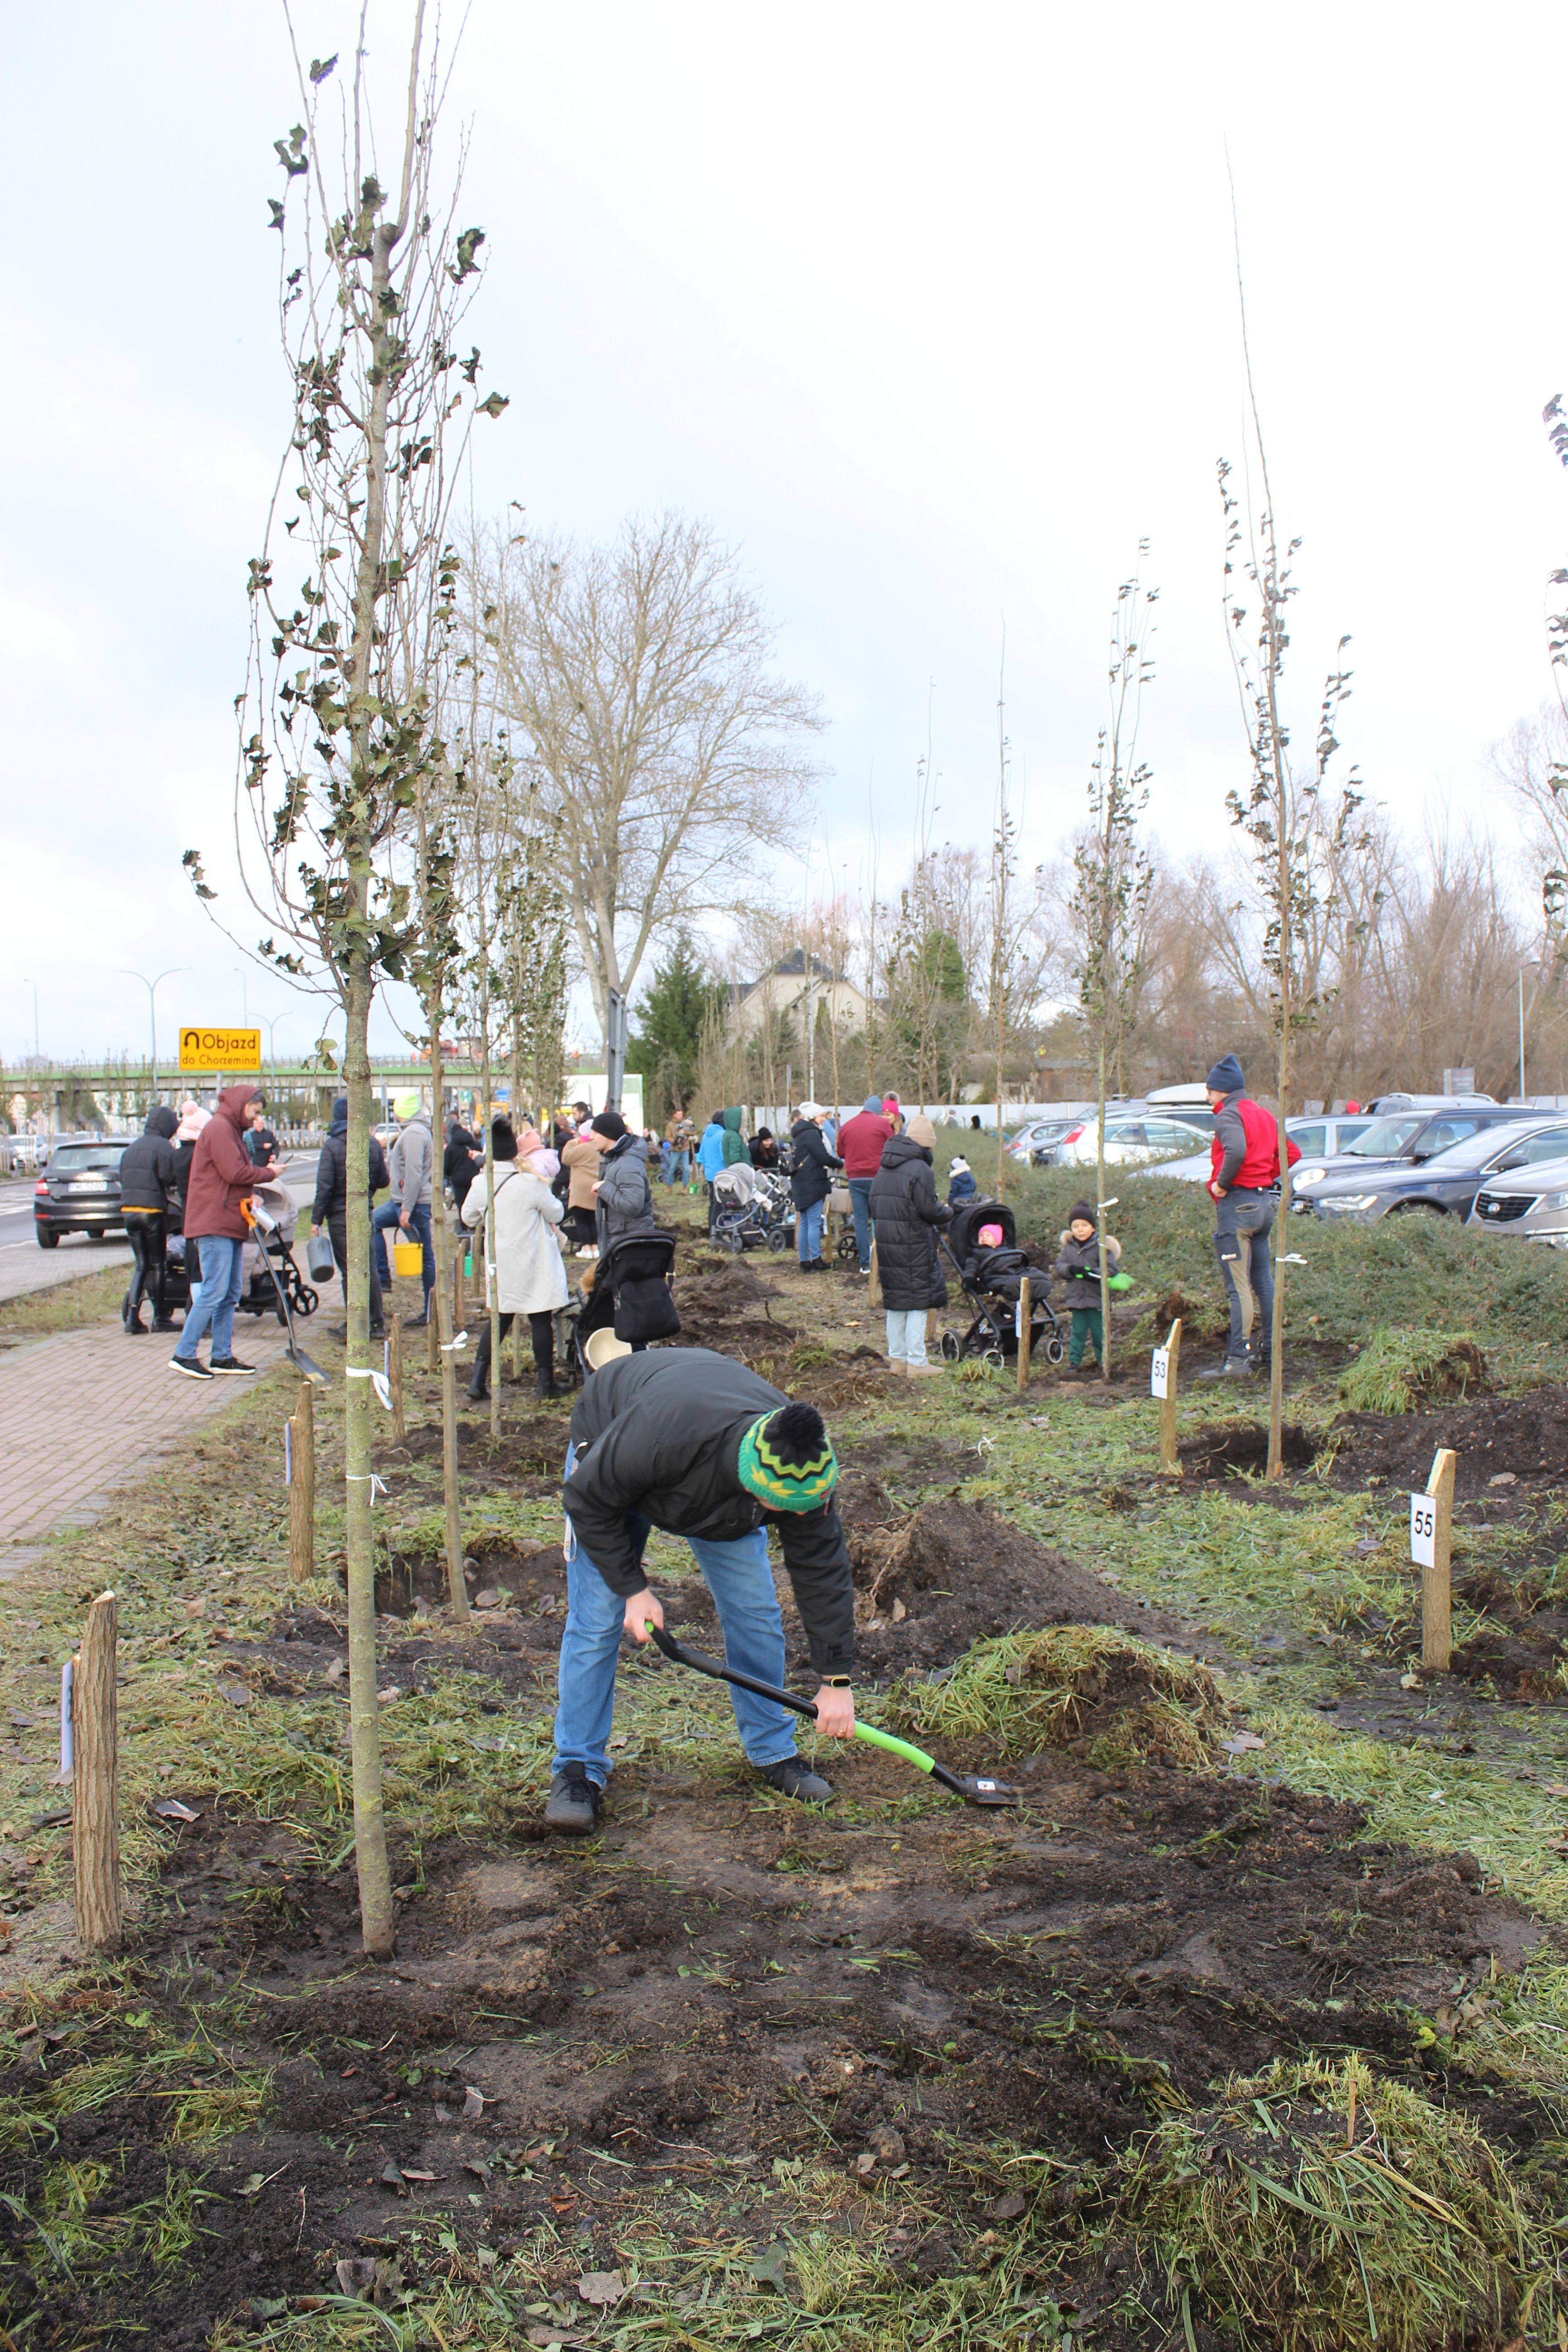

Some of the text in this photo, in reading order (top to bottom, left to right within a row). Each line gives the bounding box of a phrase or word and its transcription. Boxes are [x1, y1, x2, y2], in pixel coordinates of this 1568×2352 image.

[202, 1034, 255, 1053] Objazd
[182, 1054, 256, 1064] do Chorzemina
[1154, 1361, 1166, 1378] 53
[1414, 1510, 1432, 1537] 55
